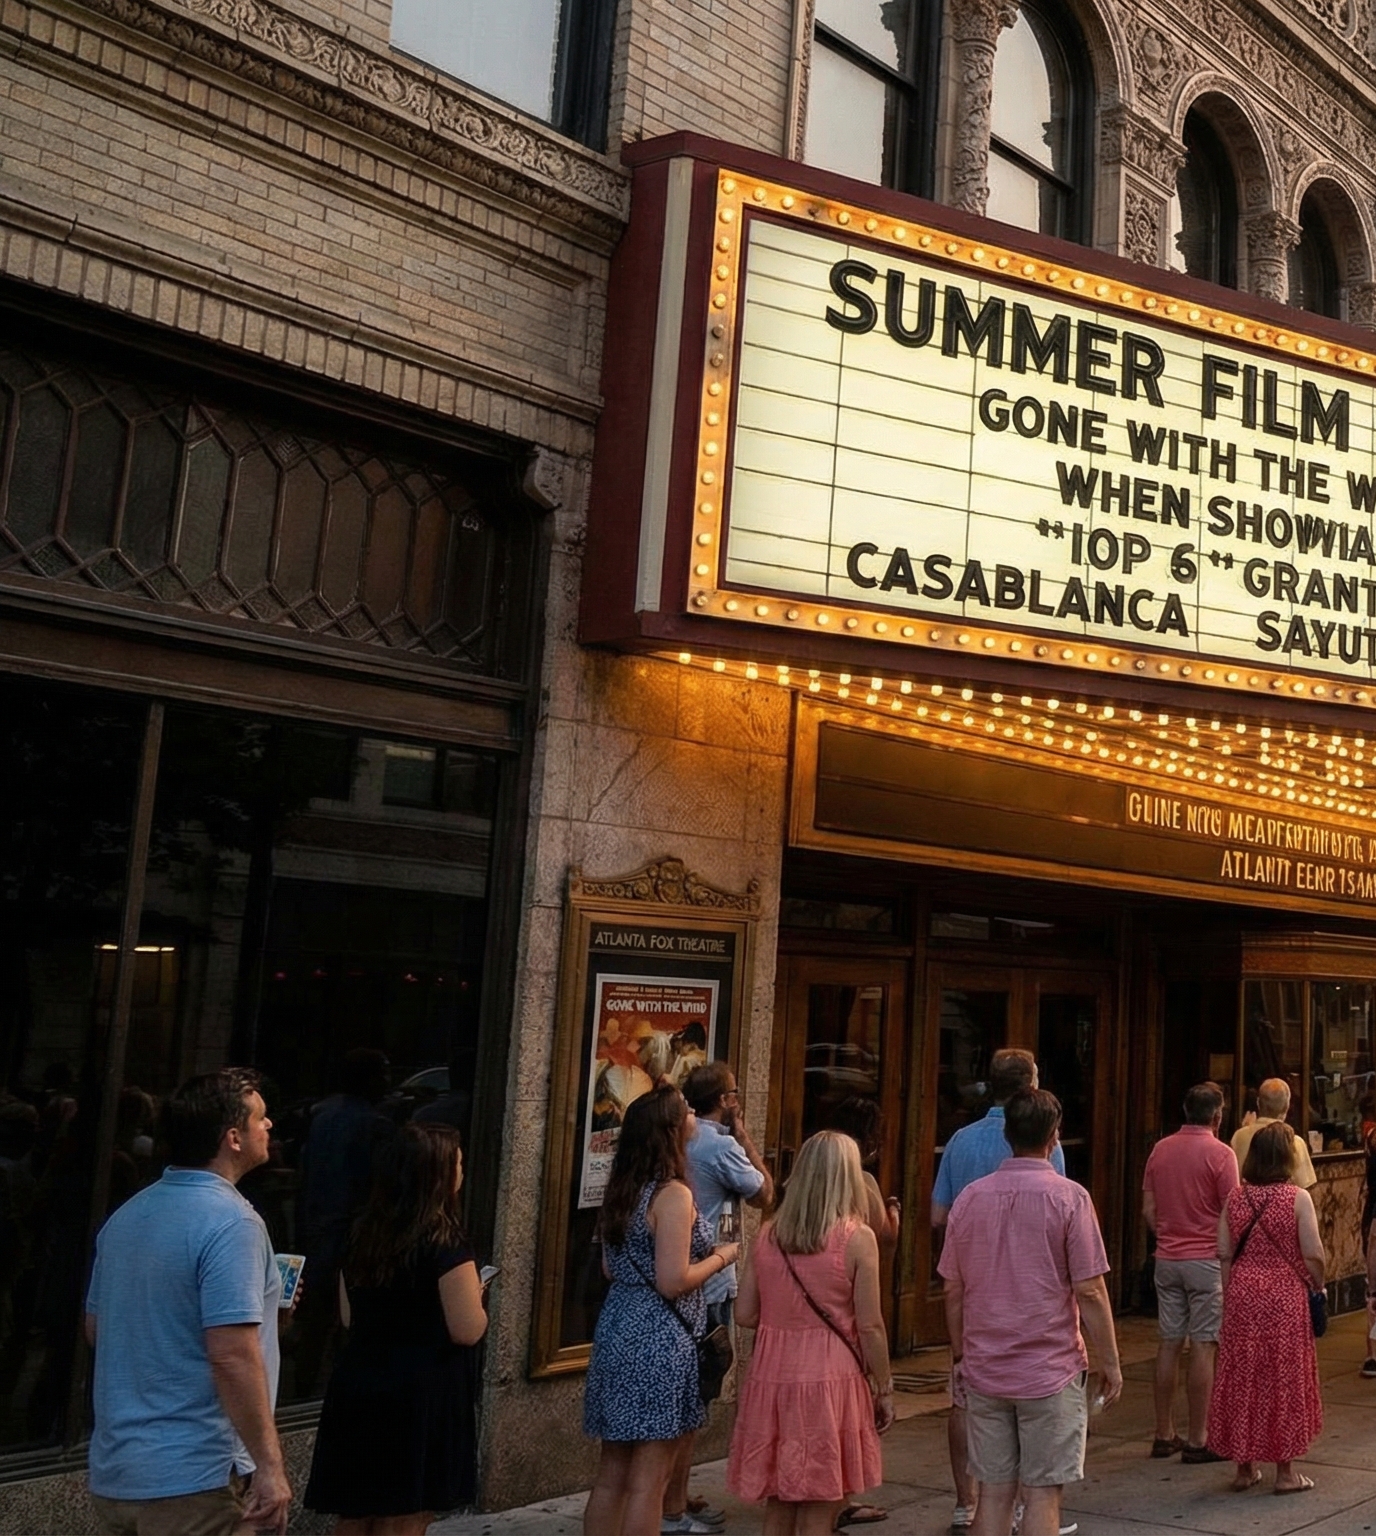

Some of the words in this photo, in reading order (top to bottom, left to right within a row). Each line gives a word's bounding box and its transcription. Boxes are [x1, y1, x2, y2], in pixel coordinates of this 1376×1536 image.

[825, 259, 1166, 408] SUMMER
[1202, 353, 1350, 452] FILM
[978, 388, 1108, 455] GONE
[1126, 418, 1237, 484] WITH
[1253, 448, 1331, 504] THE
[1056, 460, 1190, 529] WHEN
[846, 541, 1191, 637] CASABLANCA
[594, 931, 647, 948] ATLANTA
[650, 935, 675, 950] FOX
